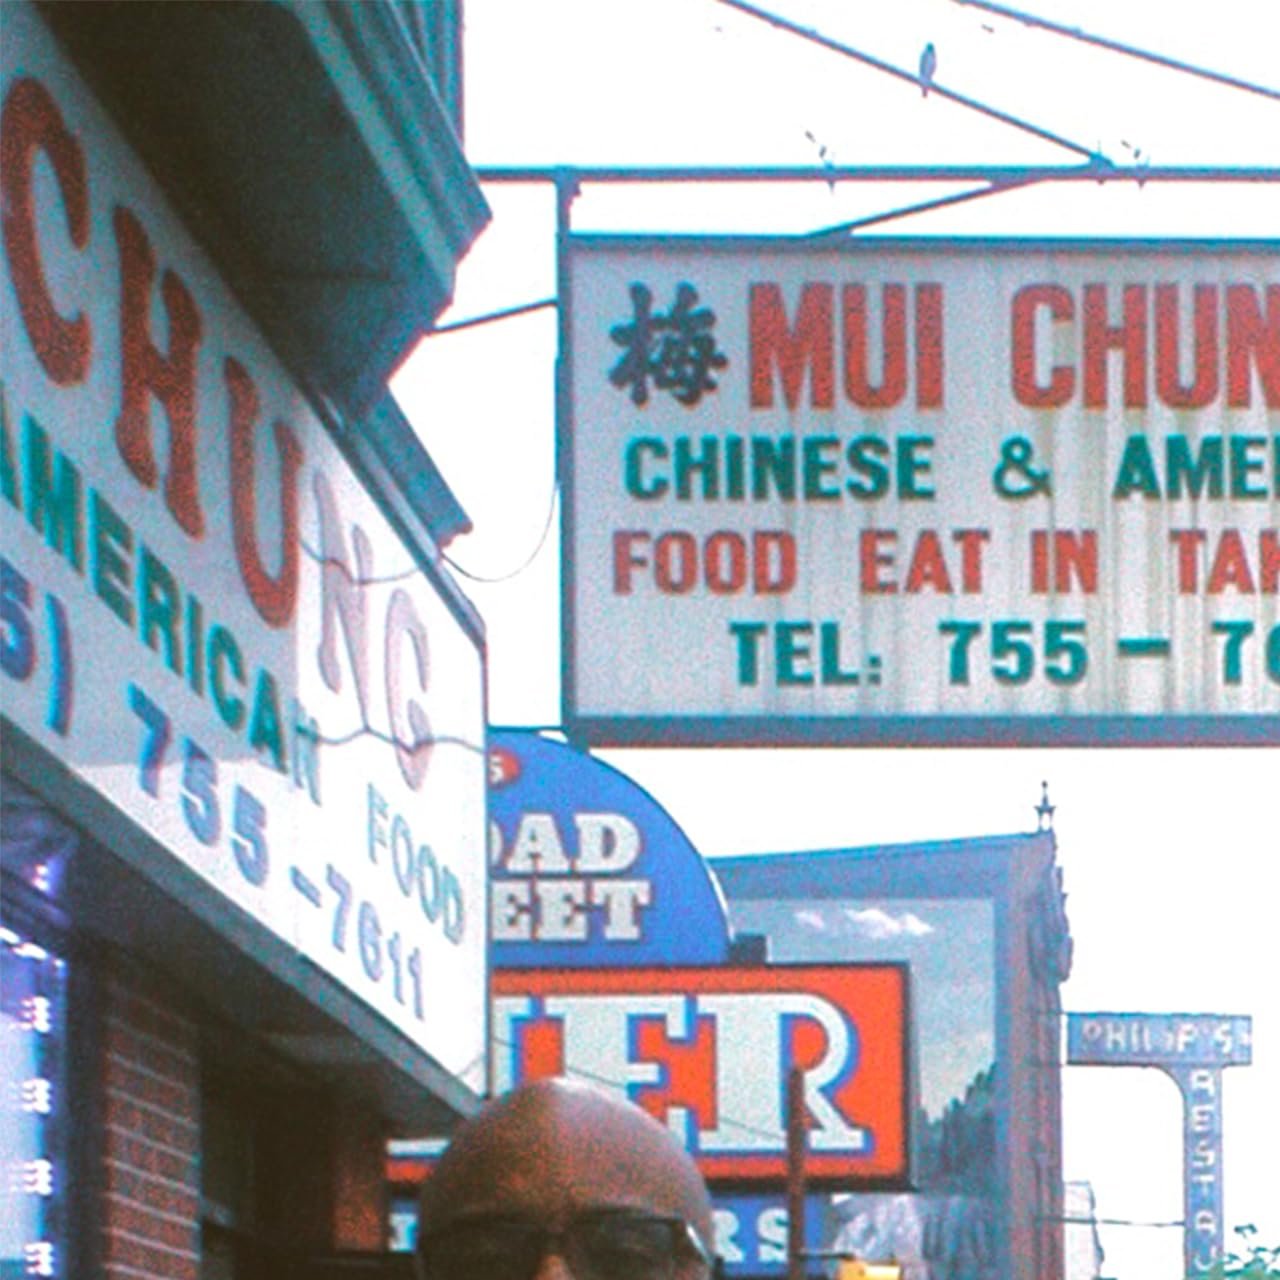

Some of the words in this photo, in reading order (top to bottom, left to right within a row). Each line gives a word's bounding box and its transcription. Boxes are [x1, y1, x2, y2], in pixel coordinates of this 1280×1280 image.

[608, 280, 729, 408] 梅
[749, 281, 944, 411] MUI
[0, 76, 434, 793] CHUNG
[624, 435, 935, 502] CHINESE
[992, 435, 1052, 500] &
[612, 529, 798, 597] FOOD
[858, 529, 990, 596] EAT
[1030, 530, 1098, 596] IN
[728, 621, 882, 686] TEL:
[366, 782, 464, 946] FOOD
[489, 812, 641, 873] AD
